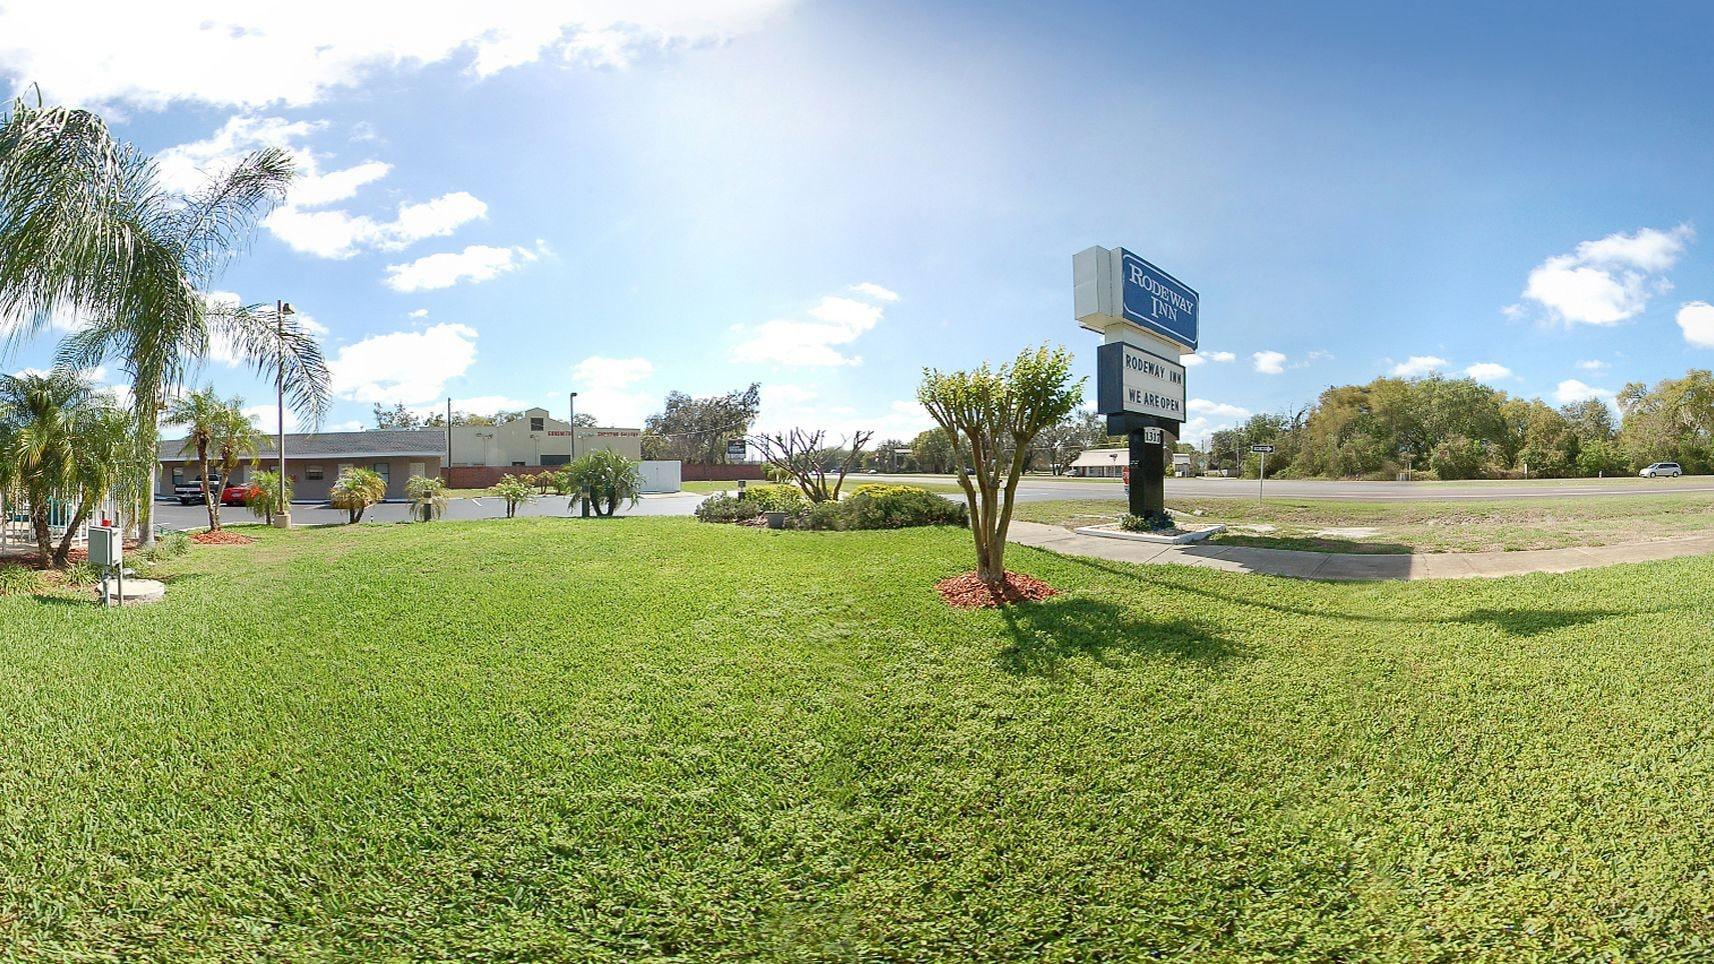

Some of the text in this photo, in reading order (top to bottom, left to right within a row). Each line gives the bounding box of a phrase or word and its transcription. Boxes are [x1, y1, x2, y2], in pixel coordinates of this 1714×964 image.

[1129, 263, 1193, 315] RODEWAY
[1151, 296, 1177, 322] INN
[1126, 354, 1181, 385] RODEWAY INN
[1129, 387, 1179, 411] WE ARE OPEN
